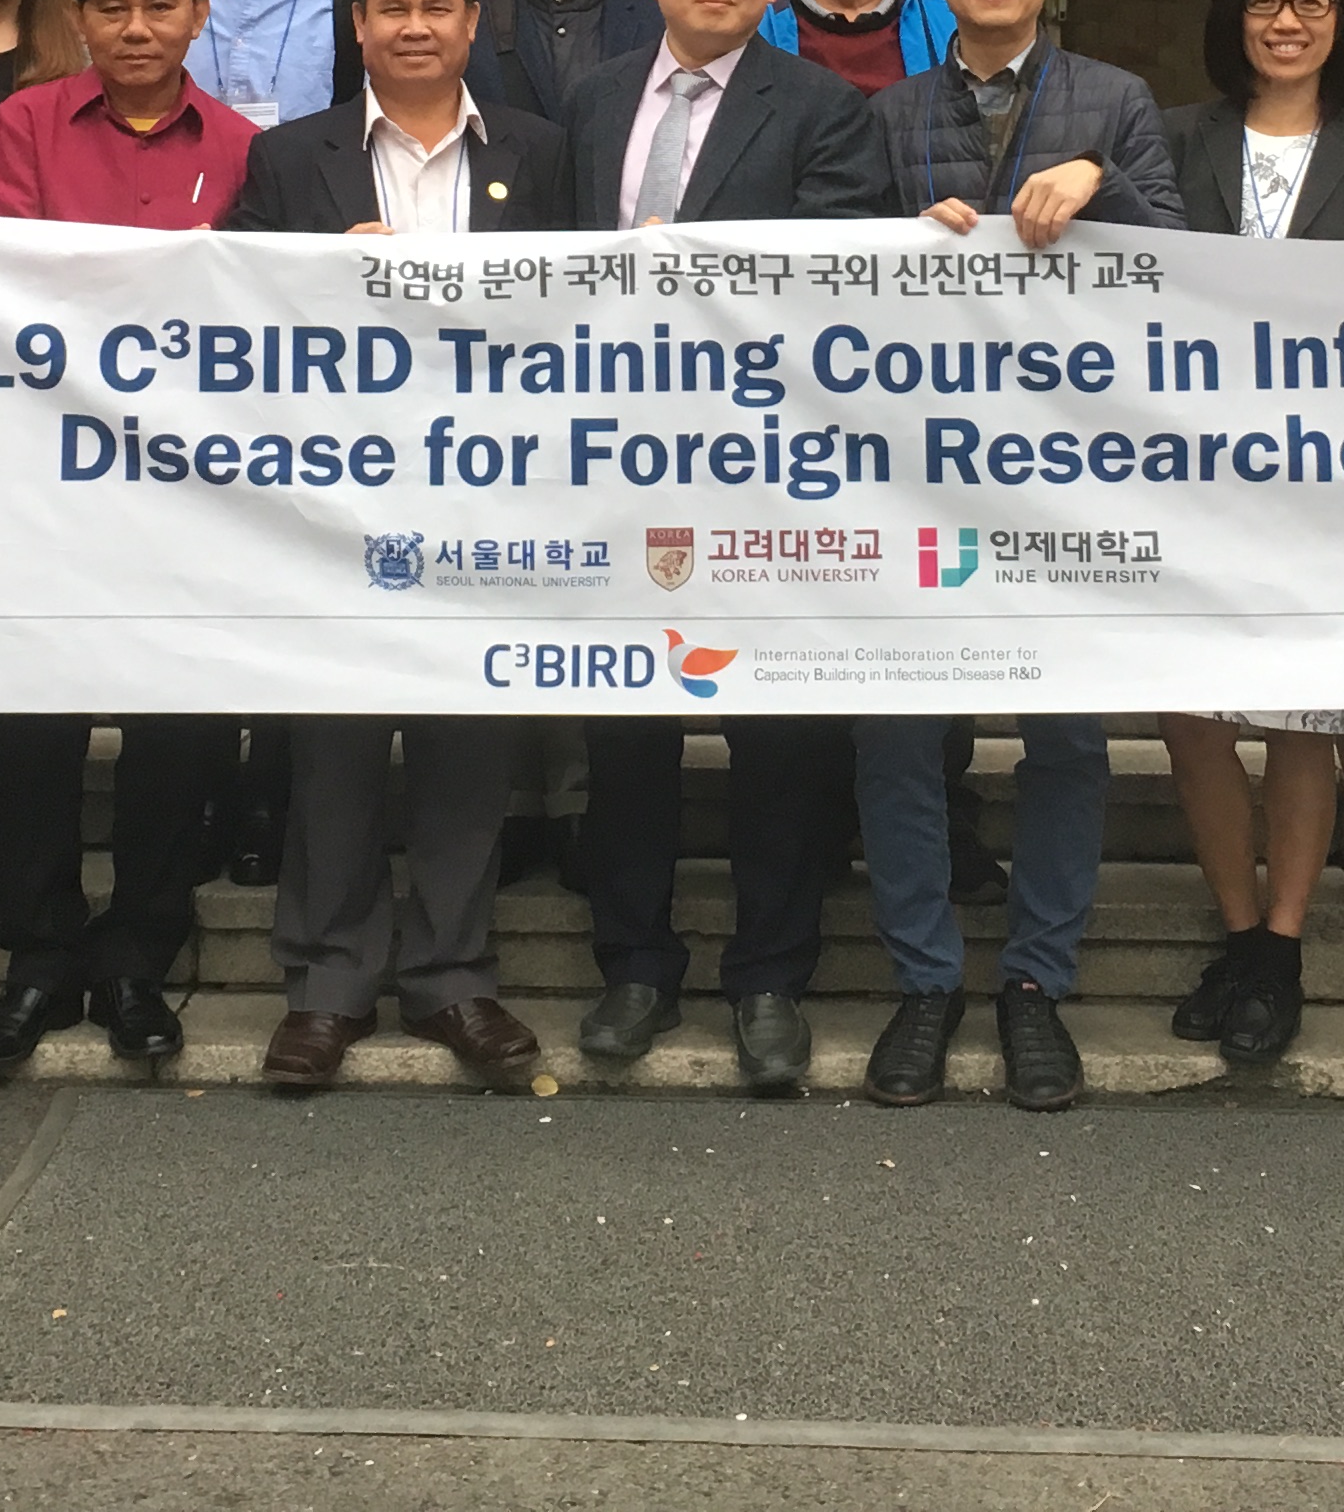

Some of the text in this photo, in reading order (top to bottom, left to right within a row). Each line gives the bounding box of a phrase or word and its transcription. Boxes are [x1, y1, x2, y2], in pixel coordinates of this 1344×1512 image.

[361, 252, 1164, 302] 감염병 분야 국제 공동연구 국외 신진연구자 교육
[439, 324, 785, 407] Training
[813, 325, 1114, 393] Course
[1148, 323, 1218, 391] in
[61, 414, 395, 486] Disease
[424, 416, 538, 486] for
[571, 414, 890, 500] Foreign
[435, 540, 610, 571] 서울대학교
[708, 528, 882, 562] 고려대학교
[990, 531, 1161, 563] 인제대학교
[437, 576, 610, 587] SEOUL NATIONAL UNIVERSITY
[712, 569, 879, 582] KOREA UNIVERSITY
[995, 568, 1159, 584] INJE UNIVERSITY
[755, 647, 1037, 661] International Collaboration Center for
[754, 667, 1041, 683] Capacity Building in Infectious Disease R&D
